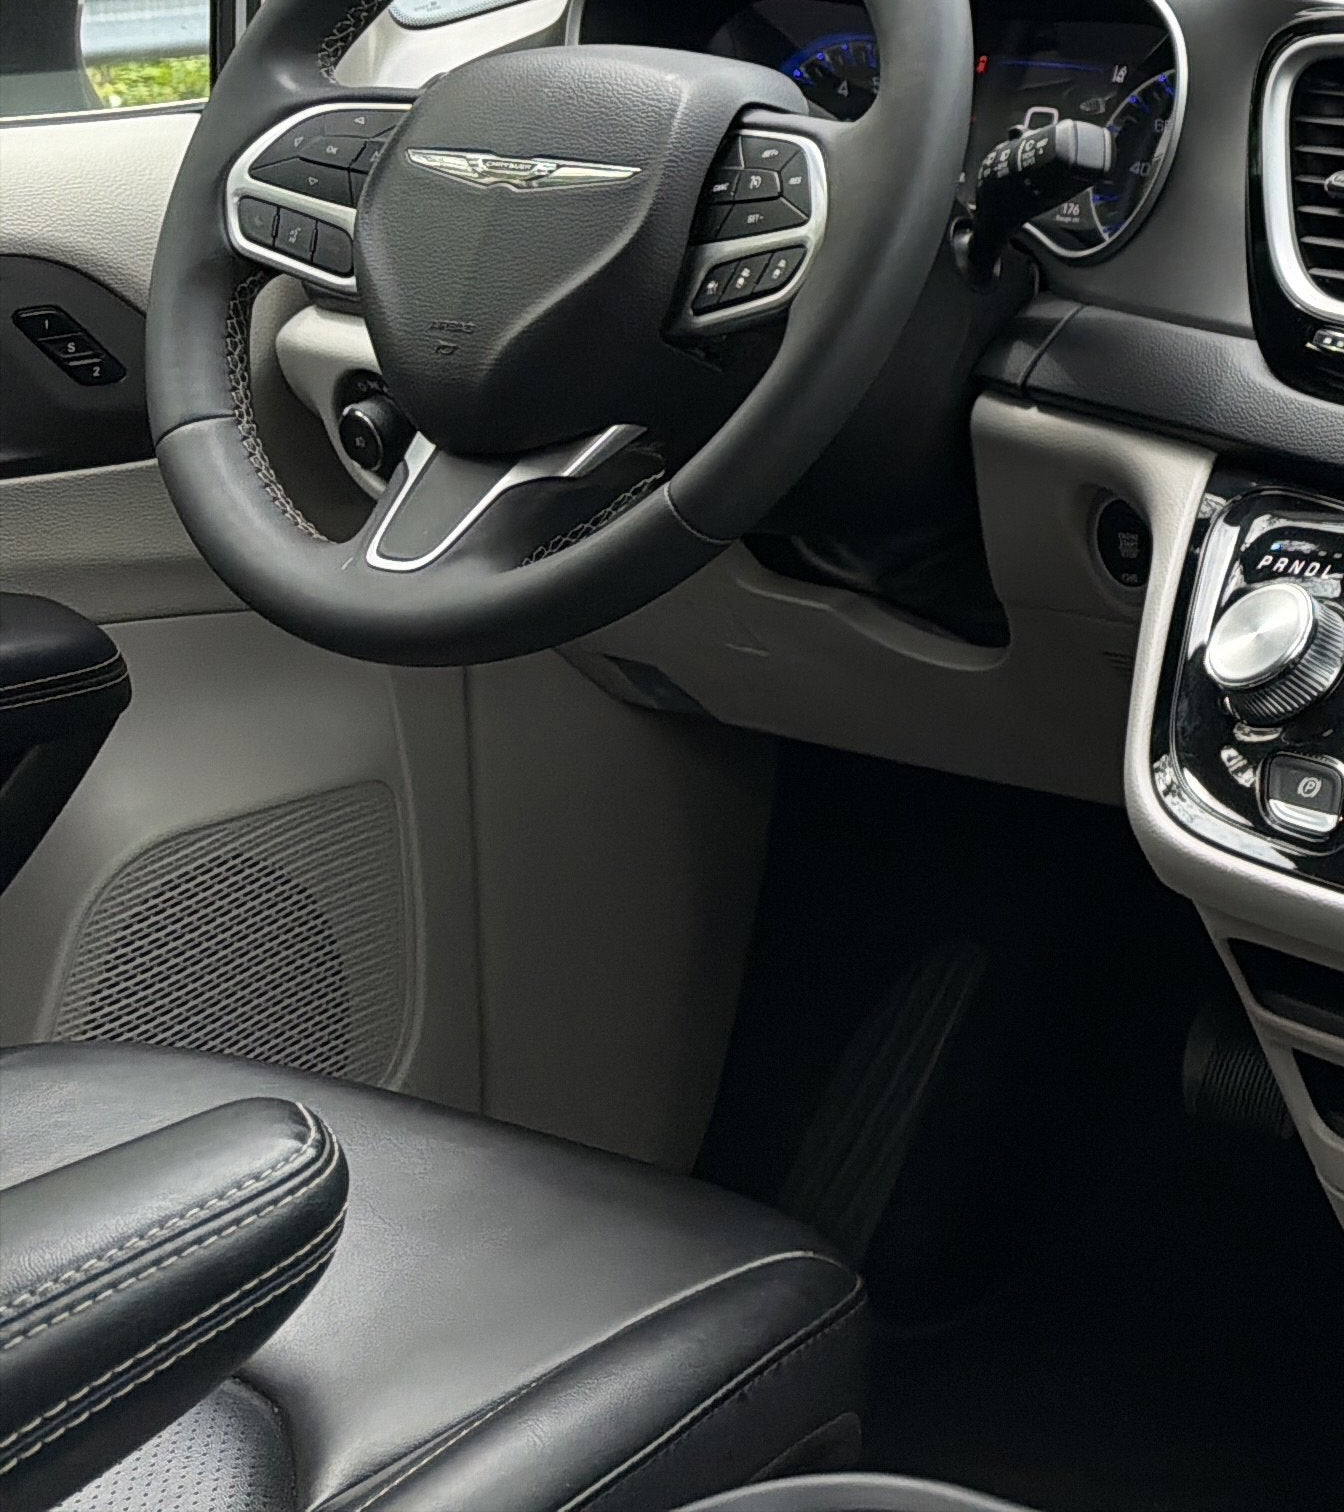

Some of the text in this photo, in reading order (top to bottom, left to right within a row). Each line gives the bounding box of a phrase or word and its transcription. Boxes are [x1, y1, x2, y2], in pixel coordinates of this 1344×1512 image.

[837, 79, 849, 97] 4
[1129, 160, 1151, 176] 40
[1061, 202, 1080, 215] 176
[66, 341, 77, 353] S
[92, 366, 101, 377] 2
